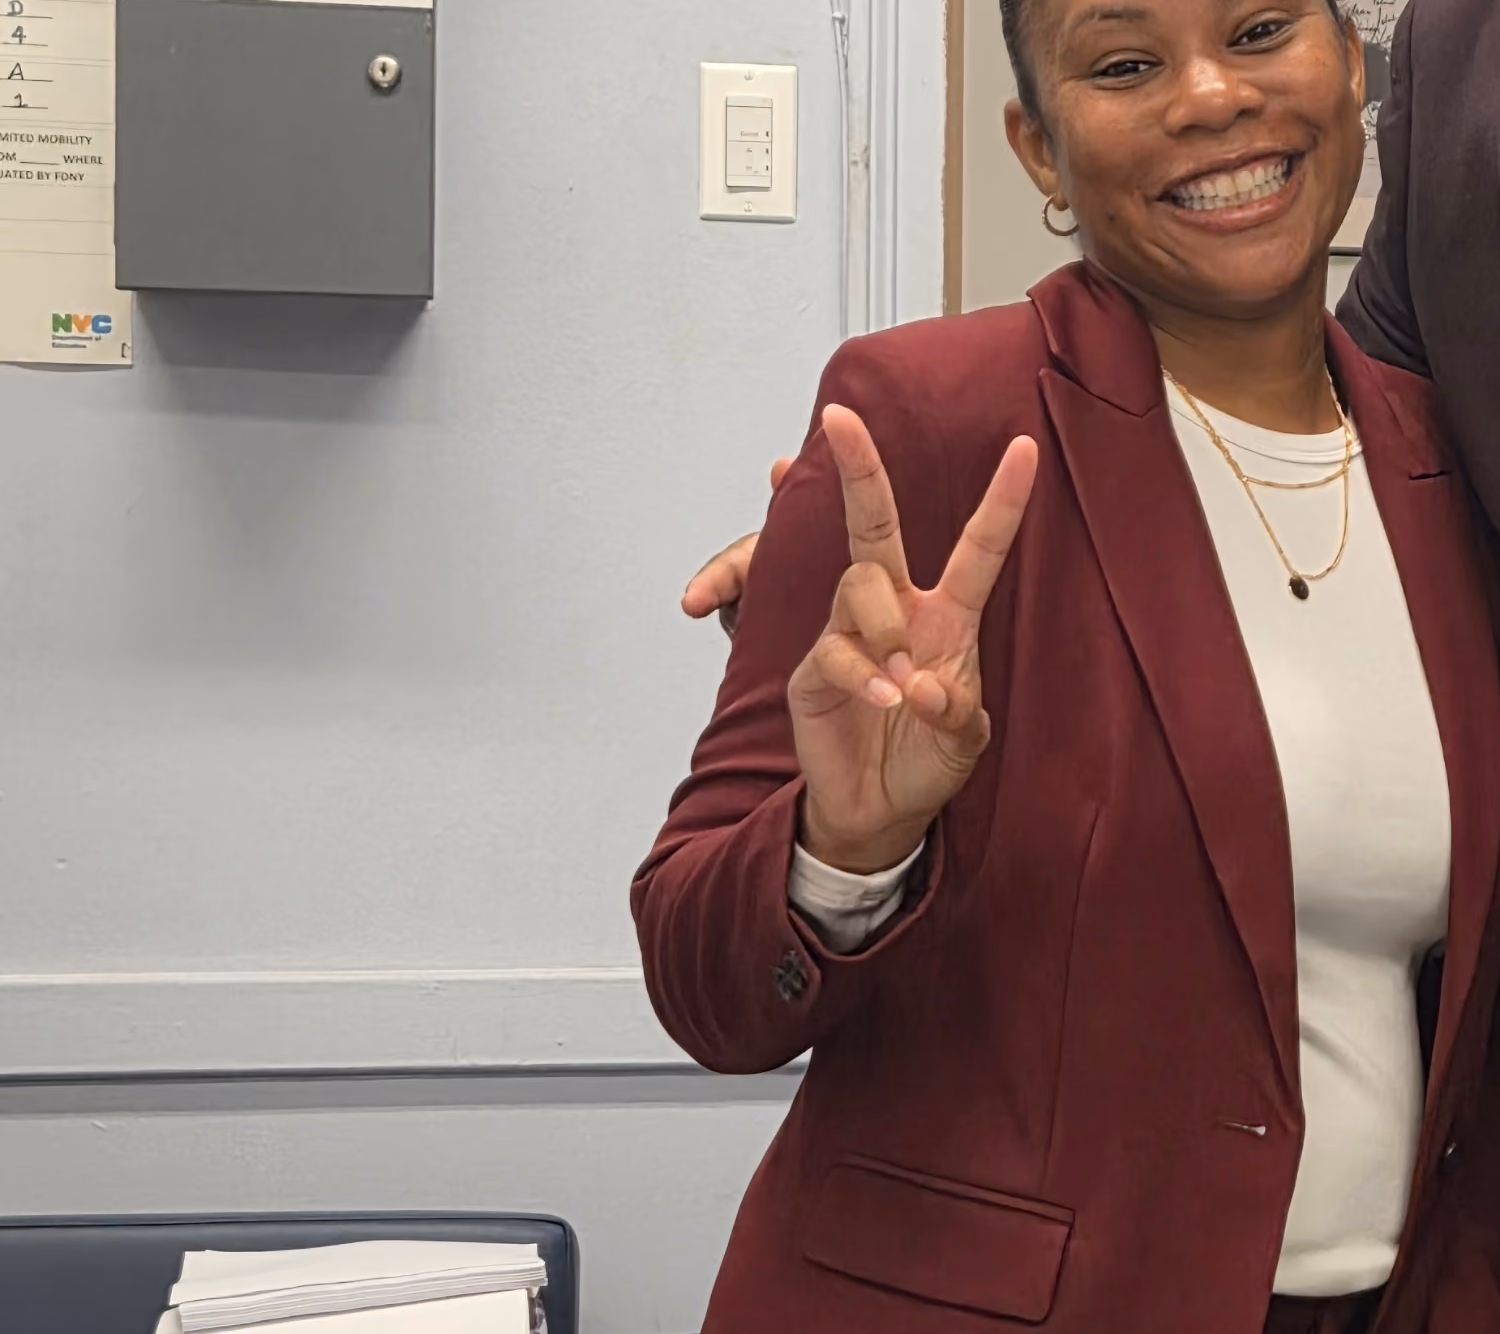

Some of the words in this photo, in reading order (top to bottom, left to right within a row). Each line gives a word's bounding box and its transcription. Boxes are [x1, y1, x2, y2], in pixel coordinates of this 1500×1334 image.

[12, 25, 27, 45] 4
[8, 62, 24, 80] A
[38, 133, 92, 145] MOBILITY
[52, 313, 112, 334] NYC
